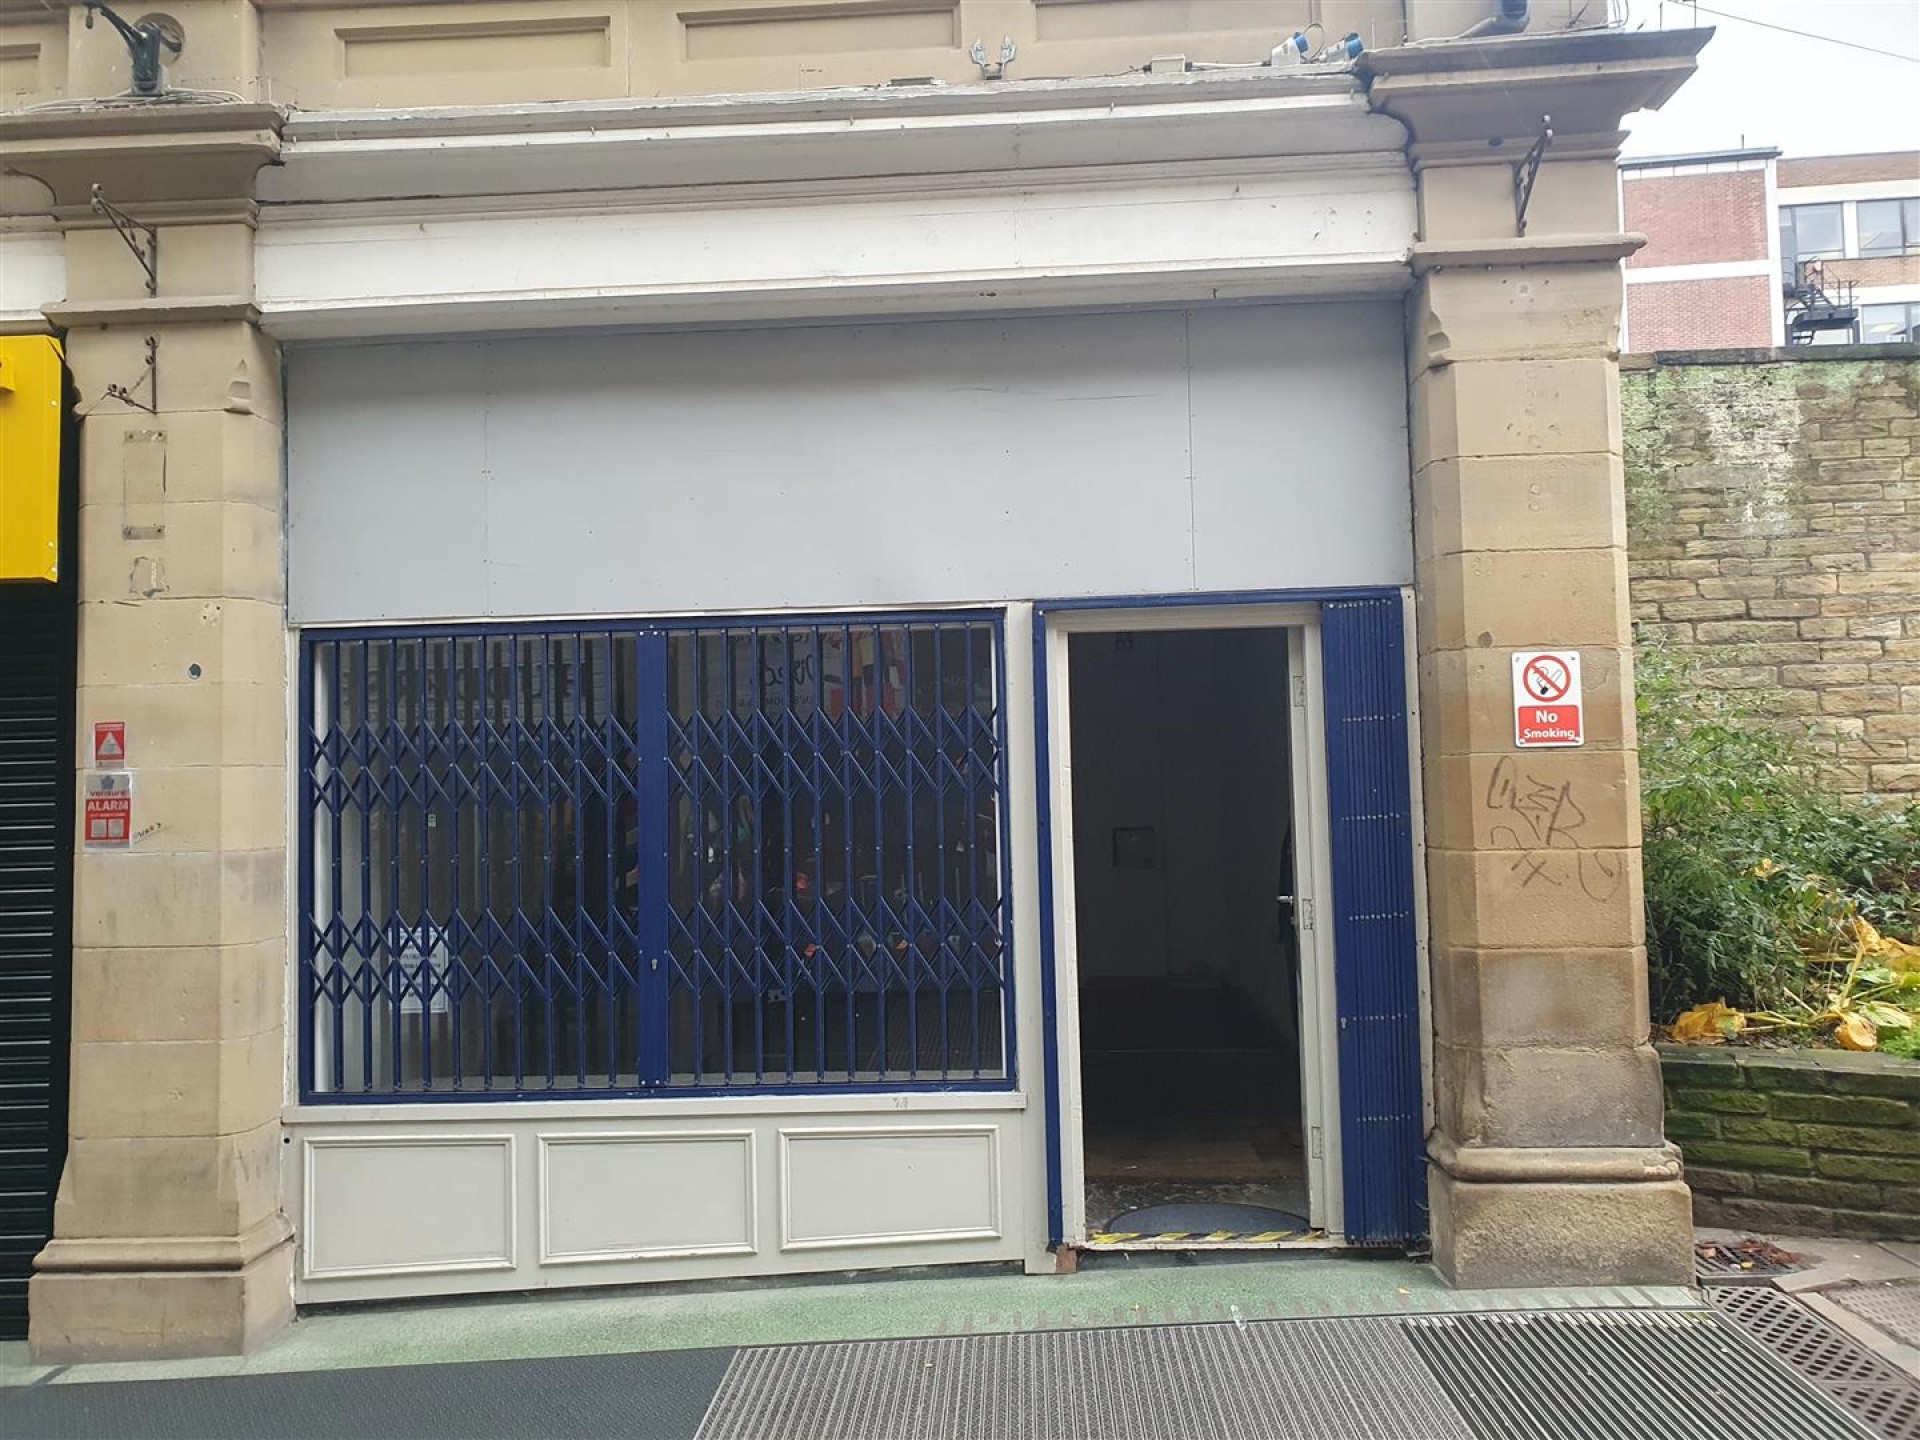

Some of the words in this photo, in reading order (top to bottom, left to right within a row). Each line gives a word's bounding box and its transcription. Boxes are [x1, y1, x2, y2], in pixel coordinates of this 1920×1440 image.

[1536, 710, 1558, 723] No
[1523, 728, 1575, 740] Smoking
[88, 800, 128, 811] ALARM
